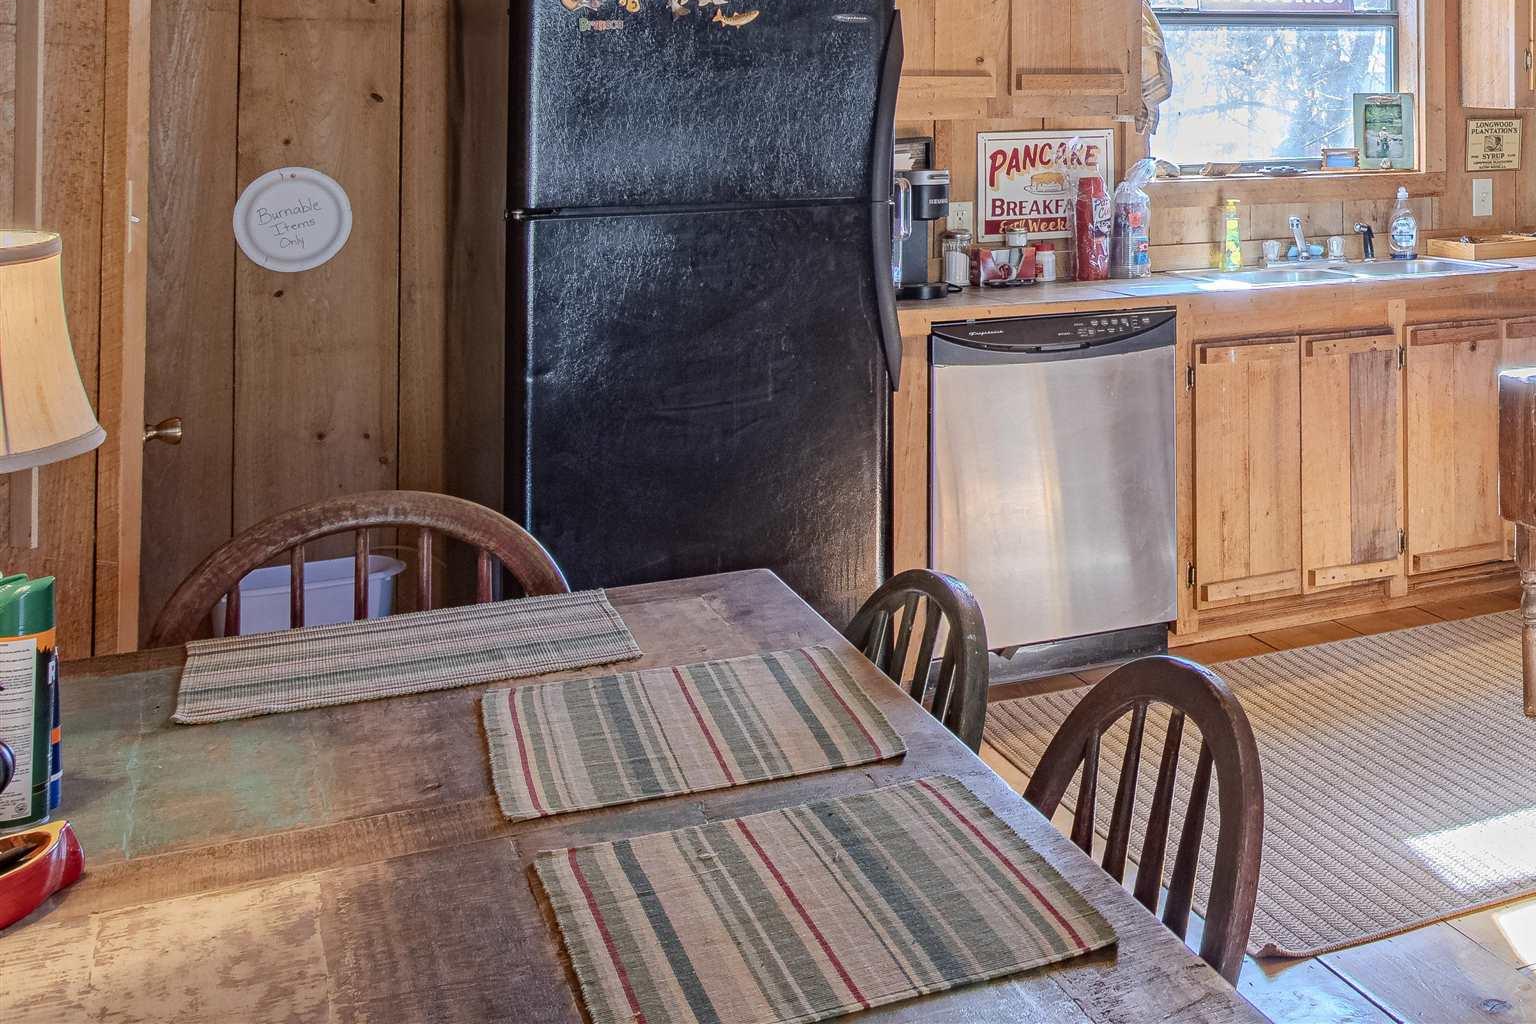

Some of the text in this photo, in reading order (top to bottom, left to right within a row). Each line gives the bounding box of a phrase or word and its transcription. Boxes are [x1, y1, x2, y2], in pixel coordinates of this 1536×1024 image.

[1475, 121, 1514, 129] LONGWOOD
[989, 142, 1099, 188] PANCAKE
[256, 197, 322, 226] Burnable
[991, 198, 1075, 217] BREAKFA
[272, 218, 316, 237] Items
[279, 234, 305, 250] Only
